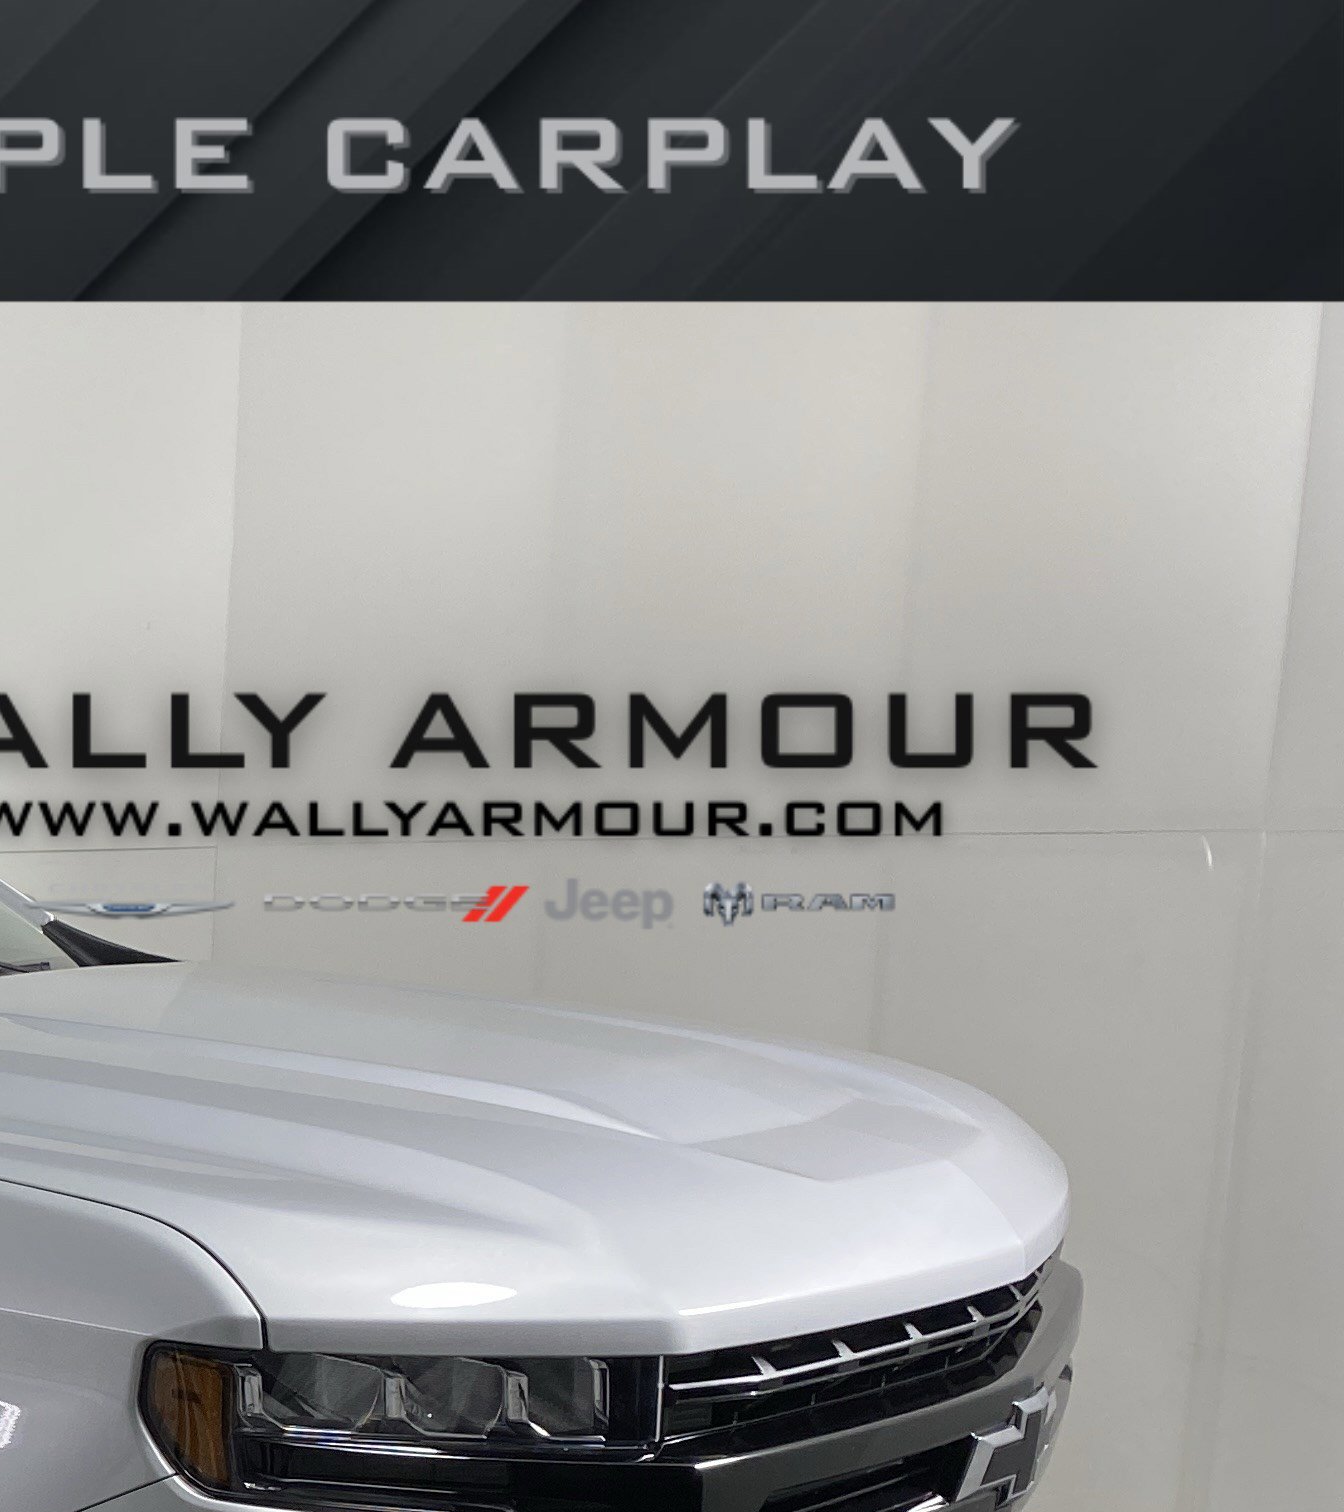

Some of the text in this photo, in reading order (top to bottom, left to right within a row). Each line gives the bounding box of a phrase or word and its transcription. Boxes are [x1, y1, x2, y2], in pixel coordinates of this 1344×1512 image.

[388, 692, 1098, 769] ARMOUR
[264, 892, 490, 912] DODGE
[544, 878, 674, 929] Jeep
[761, 892, 896, 912] RAM
